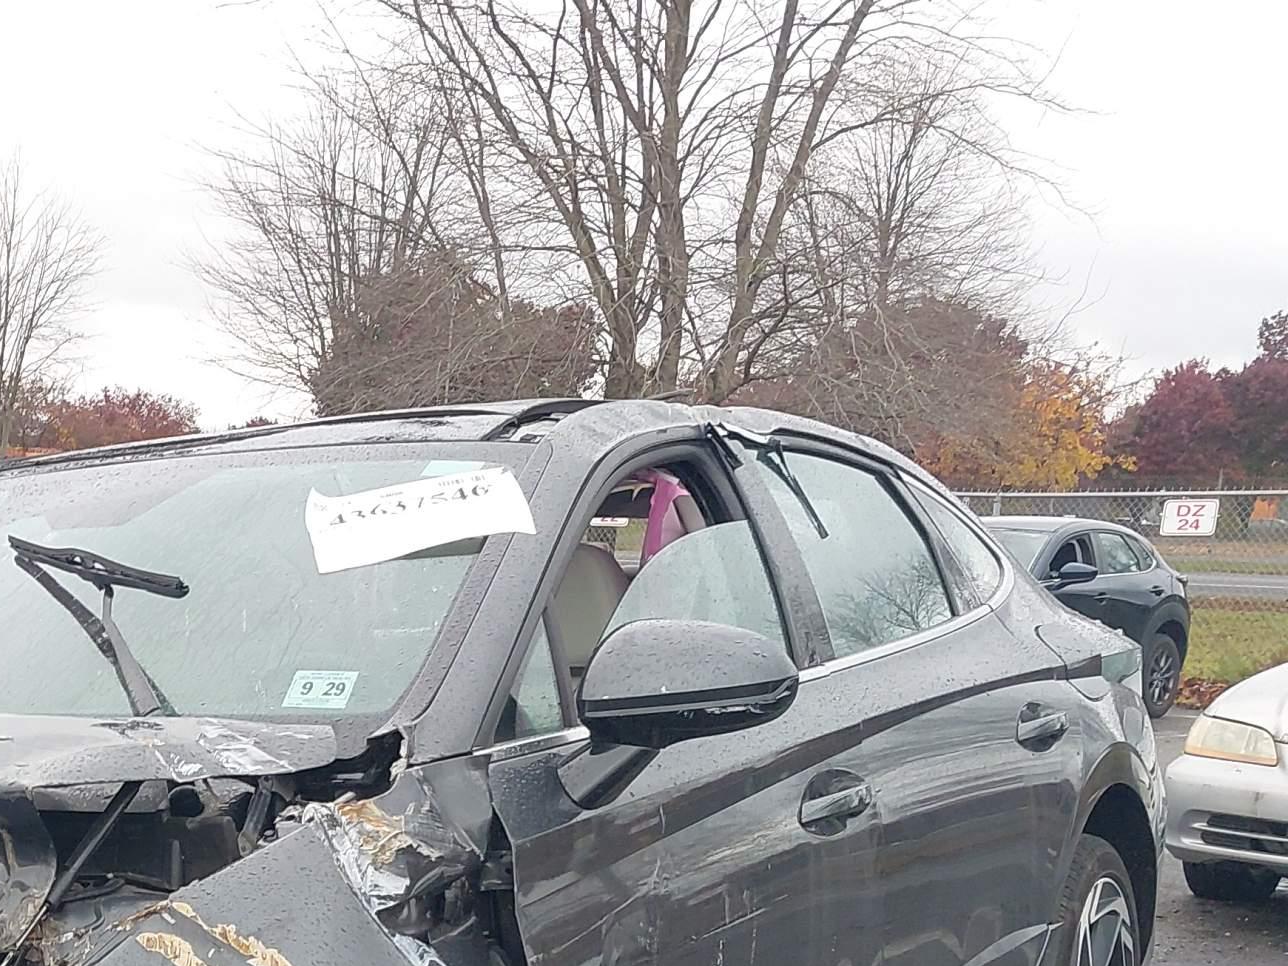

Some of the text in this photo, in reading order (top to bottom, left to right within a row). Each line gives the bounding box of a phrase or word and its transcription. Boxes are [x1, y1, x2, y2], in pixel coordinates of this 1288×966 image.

[1177, 505, 1206, 517] DZ
[1177, 519, 1200, 530] 24
[300, 682, 346, 696] 9 29
